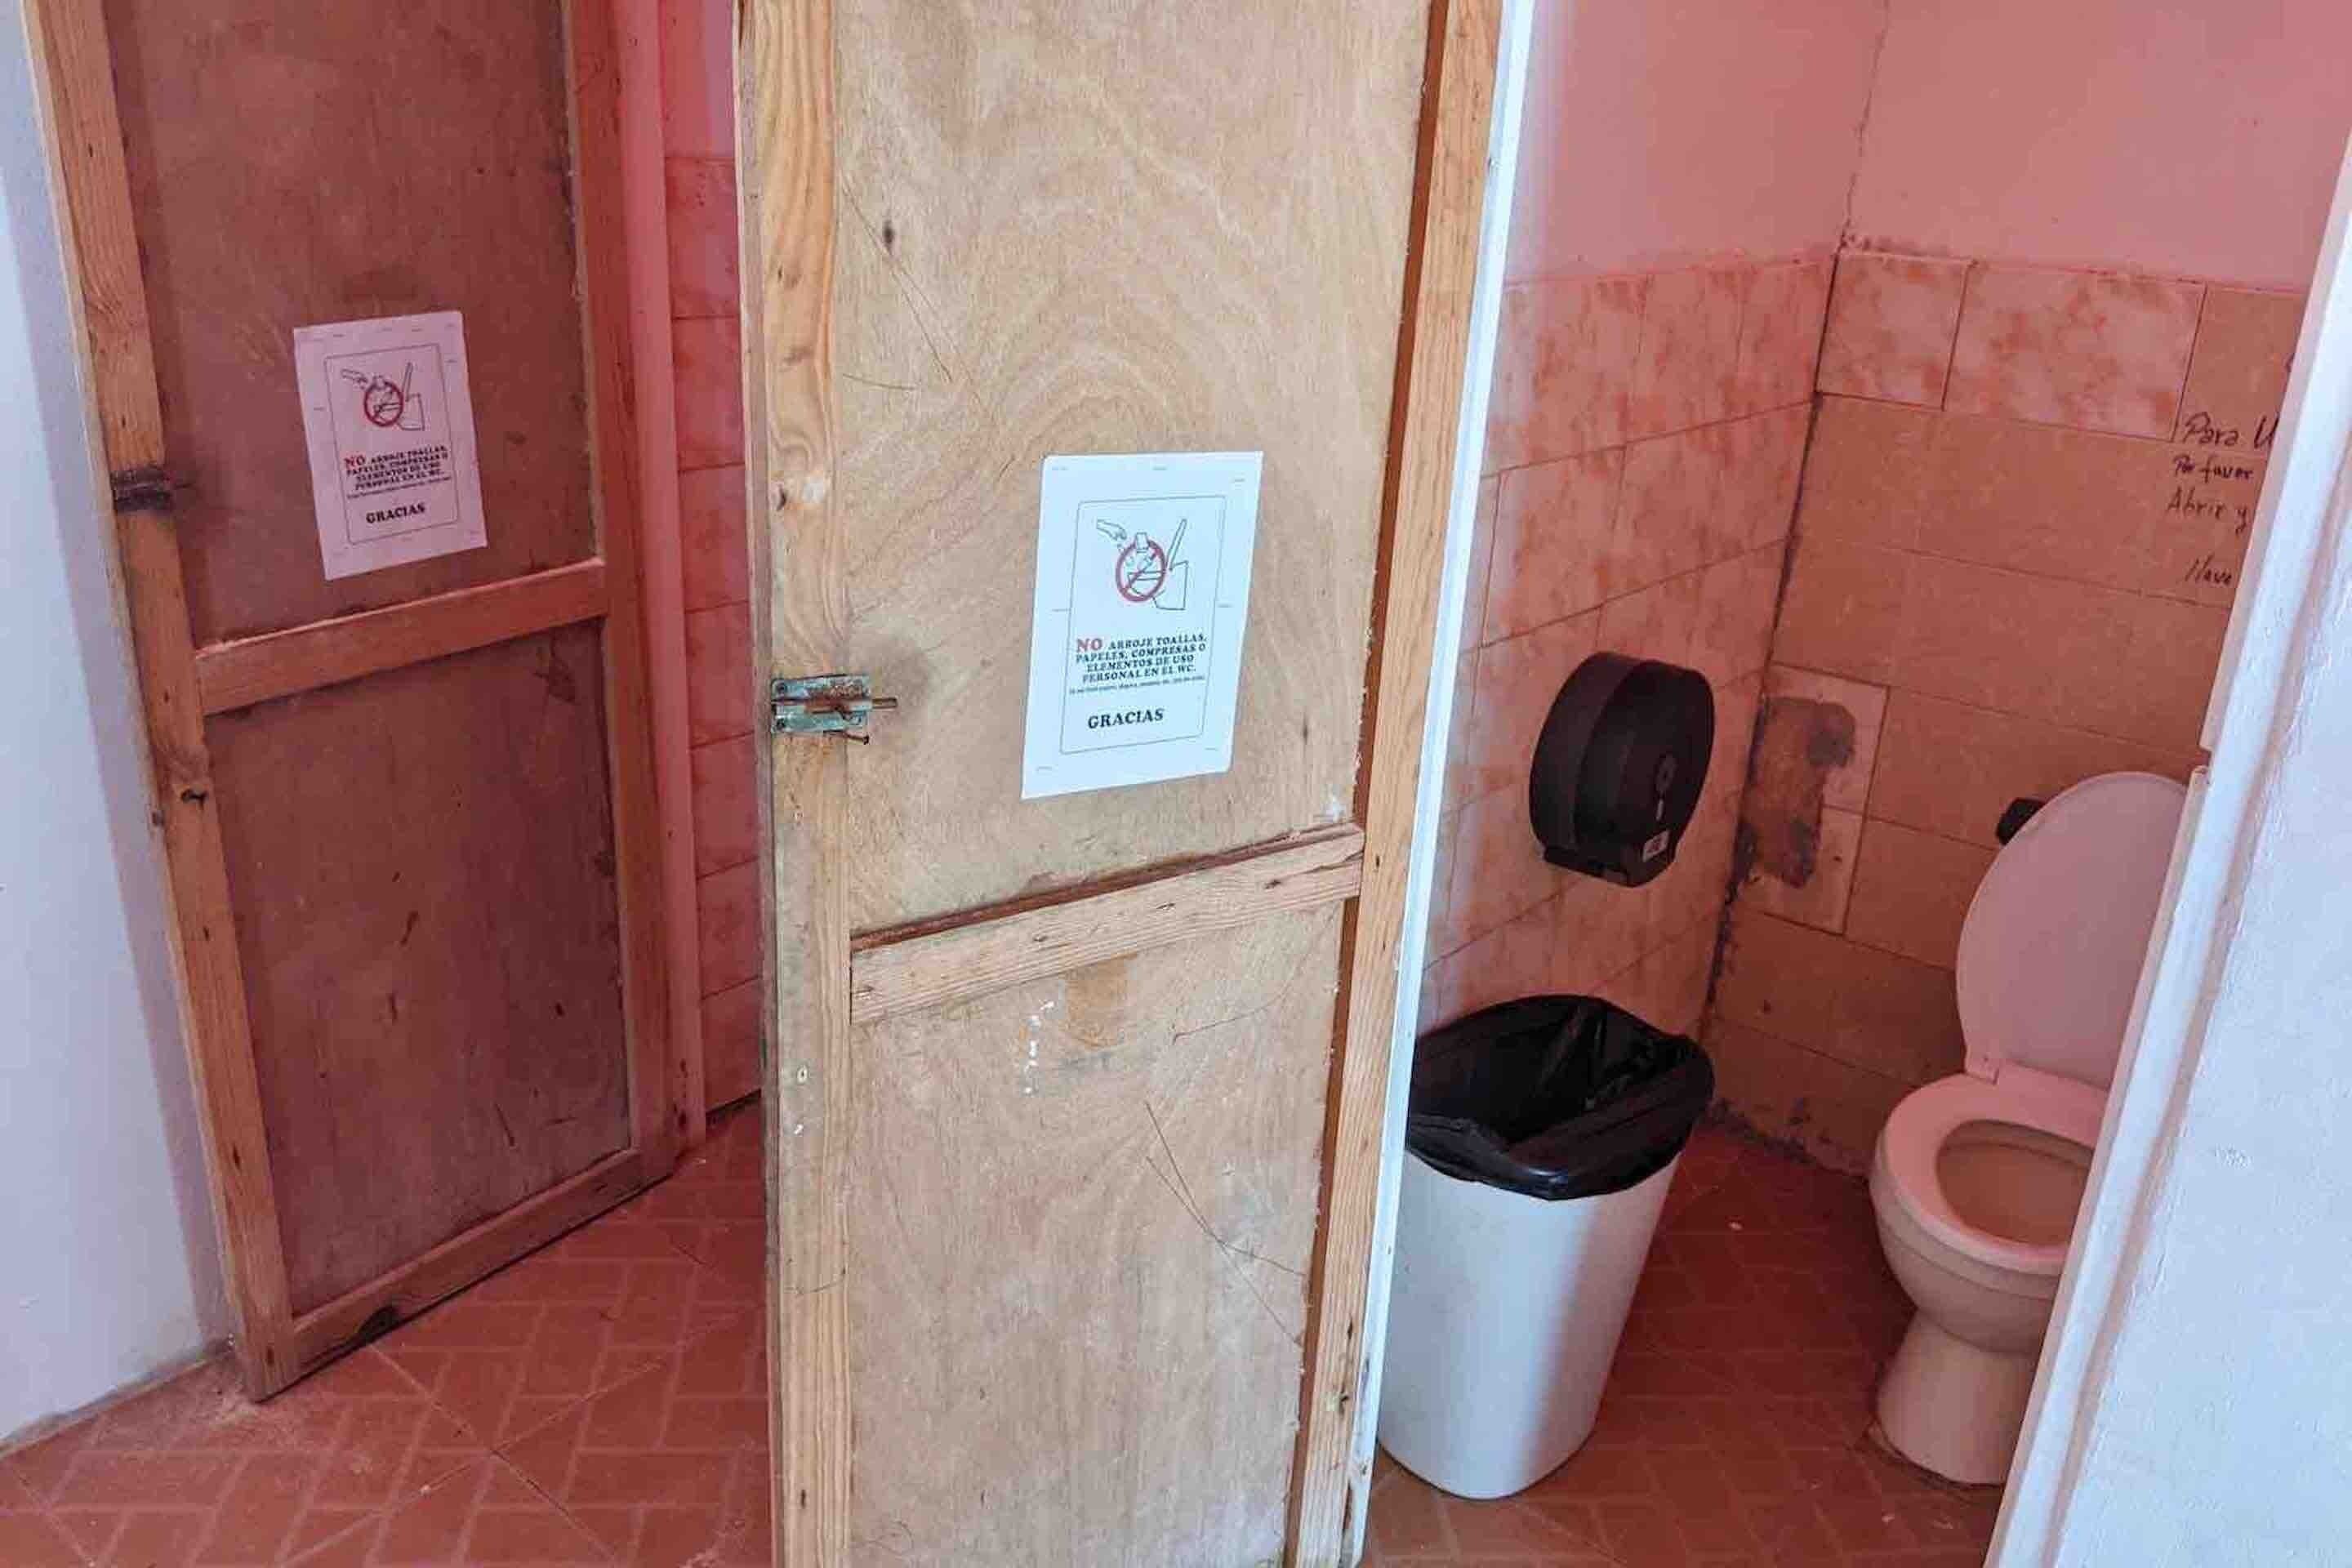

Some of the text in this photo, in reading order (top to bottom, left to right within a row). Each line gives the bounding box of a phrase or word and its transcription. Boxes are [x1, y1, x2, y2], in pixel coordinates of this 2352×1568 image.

[2183, 411, 2238, 446] Para
[344, 454, 365, 470] NO
[2167, 485, 2226, 519] Abrir
[366, 501, 425, 523] GRACIAS
[1076, 638, 1102, 653] NO
[1108, 638, 1152, 650] ARROJE
[1132, 644, 1196, 658] COMPRESAS
[1198, 643, 1206, 652] O
[1087, 654, 1194, 673] ELEMENTOS DE USO
[1082, 670, 1141, 684] PERSONAL
[1143, 668, 1158, 677] EN
[1162, 666, 1174, 675] EL
[1088, 707, 1165, 729] GRACIAS
